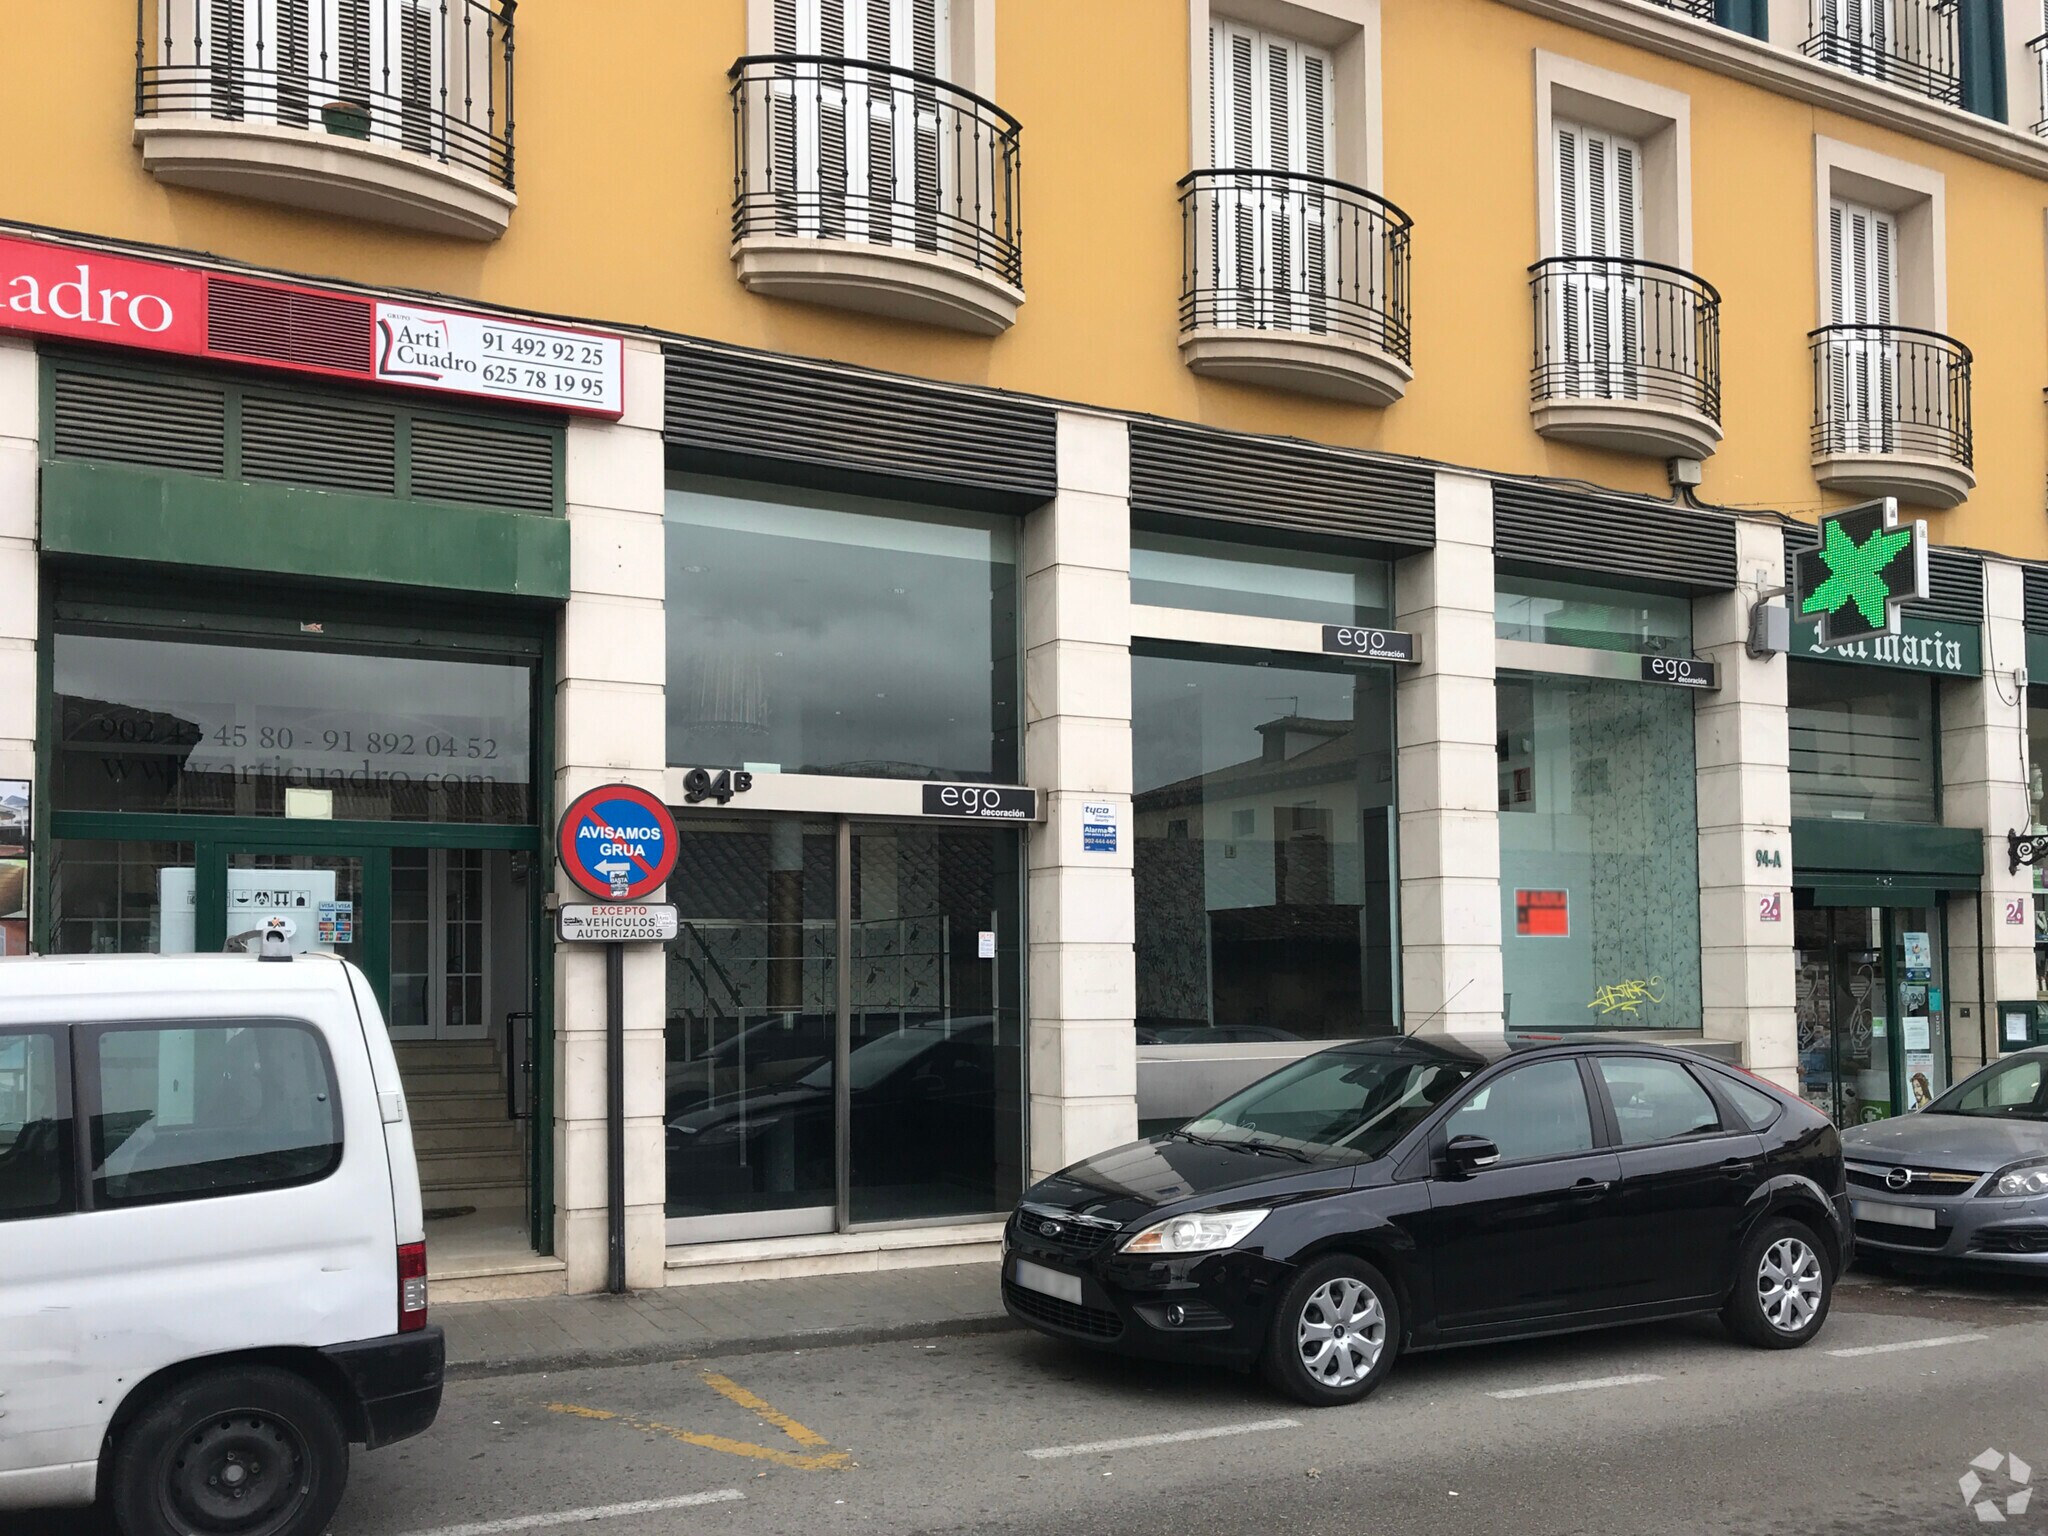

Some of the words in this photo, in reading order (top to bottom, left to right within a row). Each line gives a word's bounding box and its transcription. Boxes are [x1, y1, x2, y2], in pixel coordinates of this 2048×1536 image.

[0, 265, 173, 332] adro
[387, 312, 411, 322] GRUPO
[397, 325, 440, 348] Arti
[482, 332, 504, 351] 91
[511, 337, 546, 357] 492
[552, 343, 575, 362] 92
[581, 348, 603, 366] 25
[396, 345, 477, 373] Cuadro
[482, 364, 517, 384] 625
[524, 369, 546, 388] 78
[554, 374, 575, 392] 19
[581, 378, 603, 397] 95
[1337, 628, 1385, 653] ego
[1369, 648, 1405, 658] decoración
[1652, 658, 1691, 681] ego
[1678, 676, 1708, 685] decoración
[100, 717, 156, 743] 902
[213, 724, 247, 747] 45
[260, 727, 293, 750] 80
[323, 730, 356, 752] 91
[367, 732, 415, 755] 892
[426, 735, 458, 758] 04
[467, 738, 499, 760] 52
[940, 787, 1000, 814] ego
[981, 808, 1025, 818] decoración
[1085, 806, 1110, 815] tyco
[579, 826, 661, 840] AVISAMOS
[600, 843, 646, 857] GRUA
[592, 906, 648, 916] EXCEPTO
[585, 916, 656, 927] VEHÍCULOS
[576, 928, 663, 939] AUTORIZADOS
